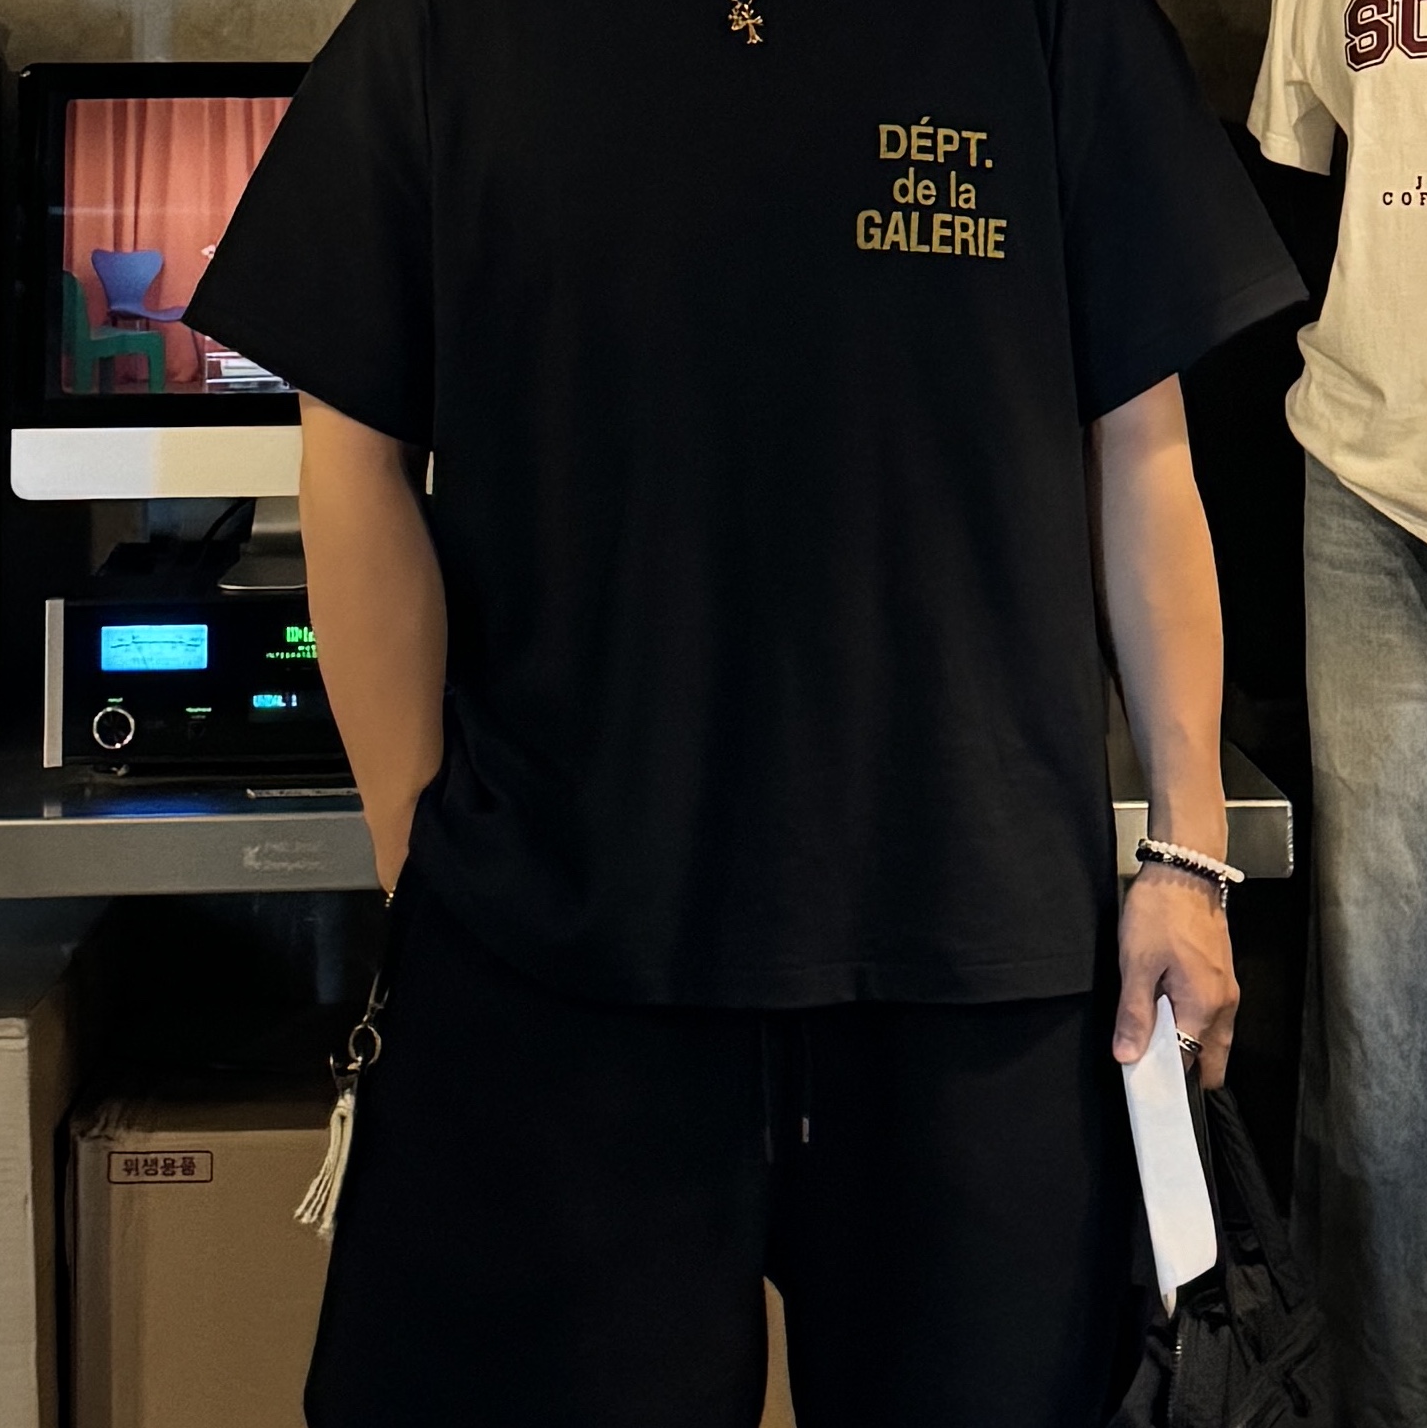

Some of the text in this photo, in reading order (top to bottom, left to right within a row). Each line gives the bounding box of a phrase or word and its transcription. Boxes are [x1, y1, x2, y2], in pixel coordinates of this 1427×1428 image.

[878, 116, 993, 168] DÉPT.
[893, 167, 976, 210] de la
[856, 209, 1008, 259] GALERIE
[122, 1156, 196, 1177] 위생용품
